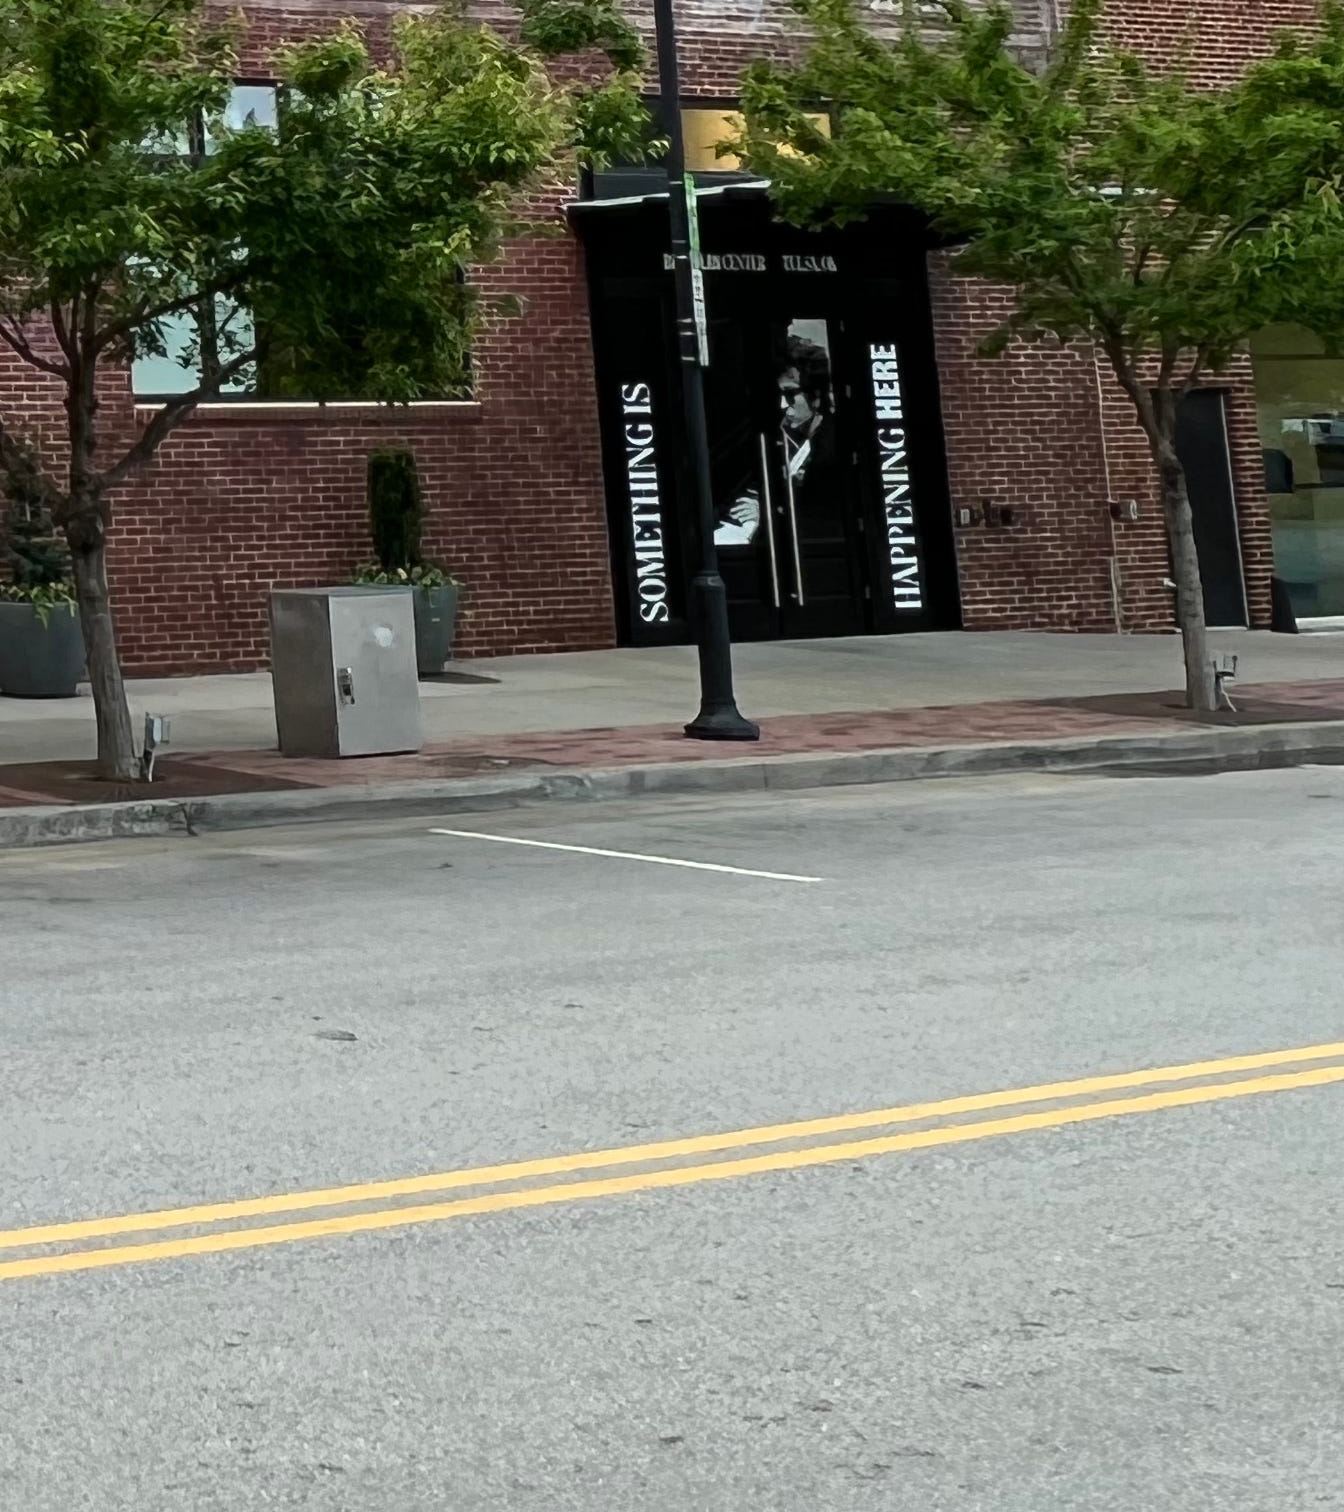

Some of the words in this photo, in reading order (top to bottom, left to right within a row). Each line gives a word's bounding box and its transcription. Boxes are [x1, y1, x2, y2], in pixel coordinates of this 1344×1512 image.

[621, 382, 652, 414] IS
[870, 343, 904, 420] HERE
[625, 423, 669, 623] SOMETHING
[877, 428, 923, 609] HAPPENING
